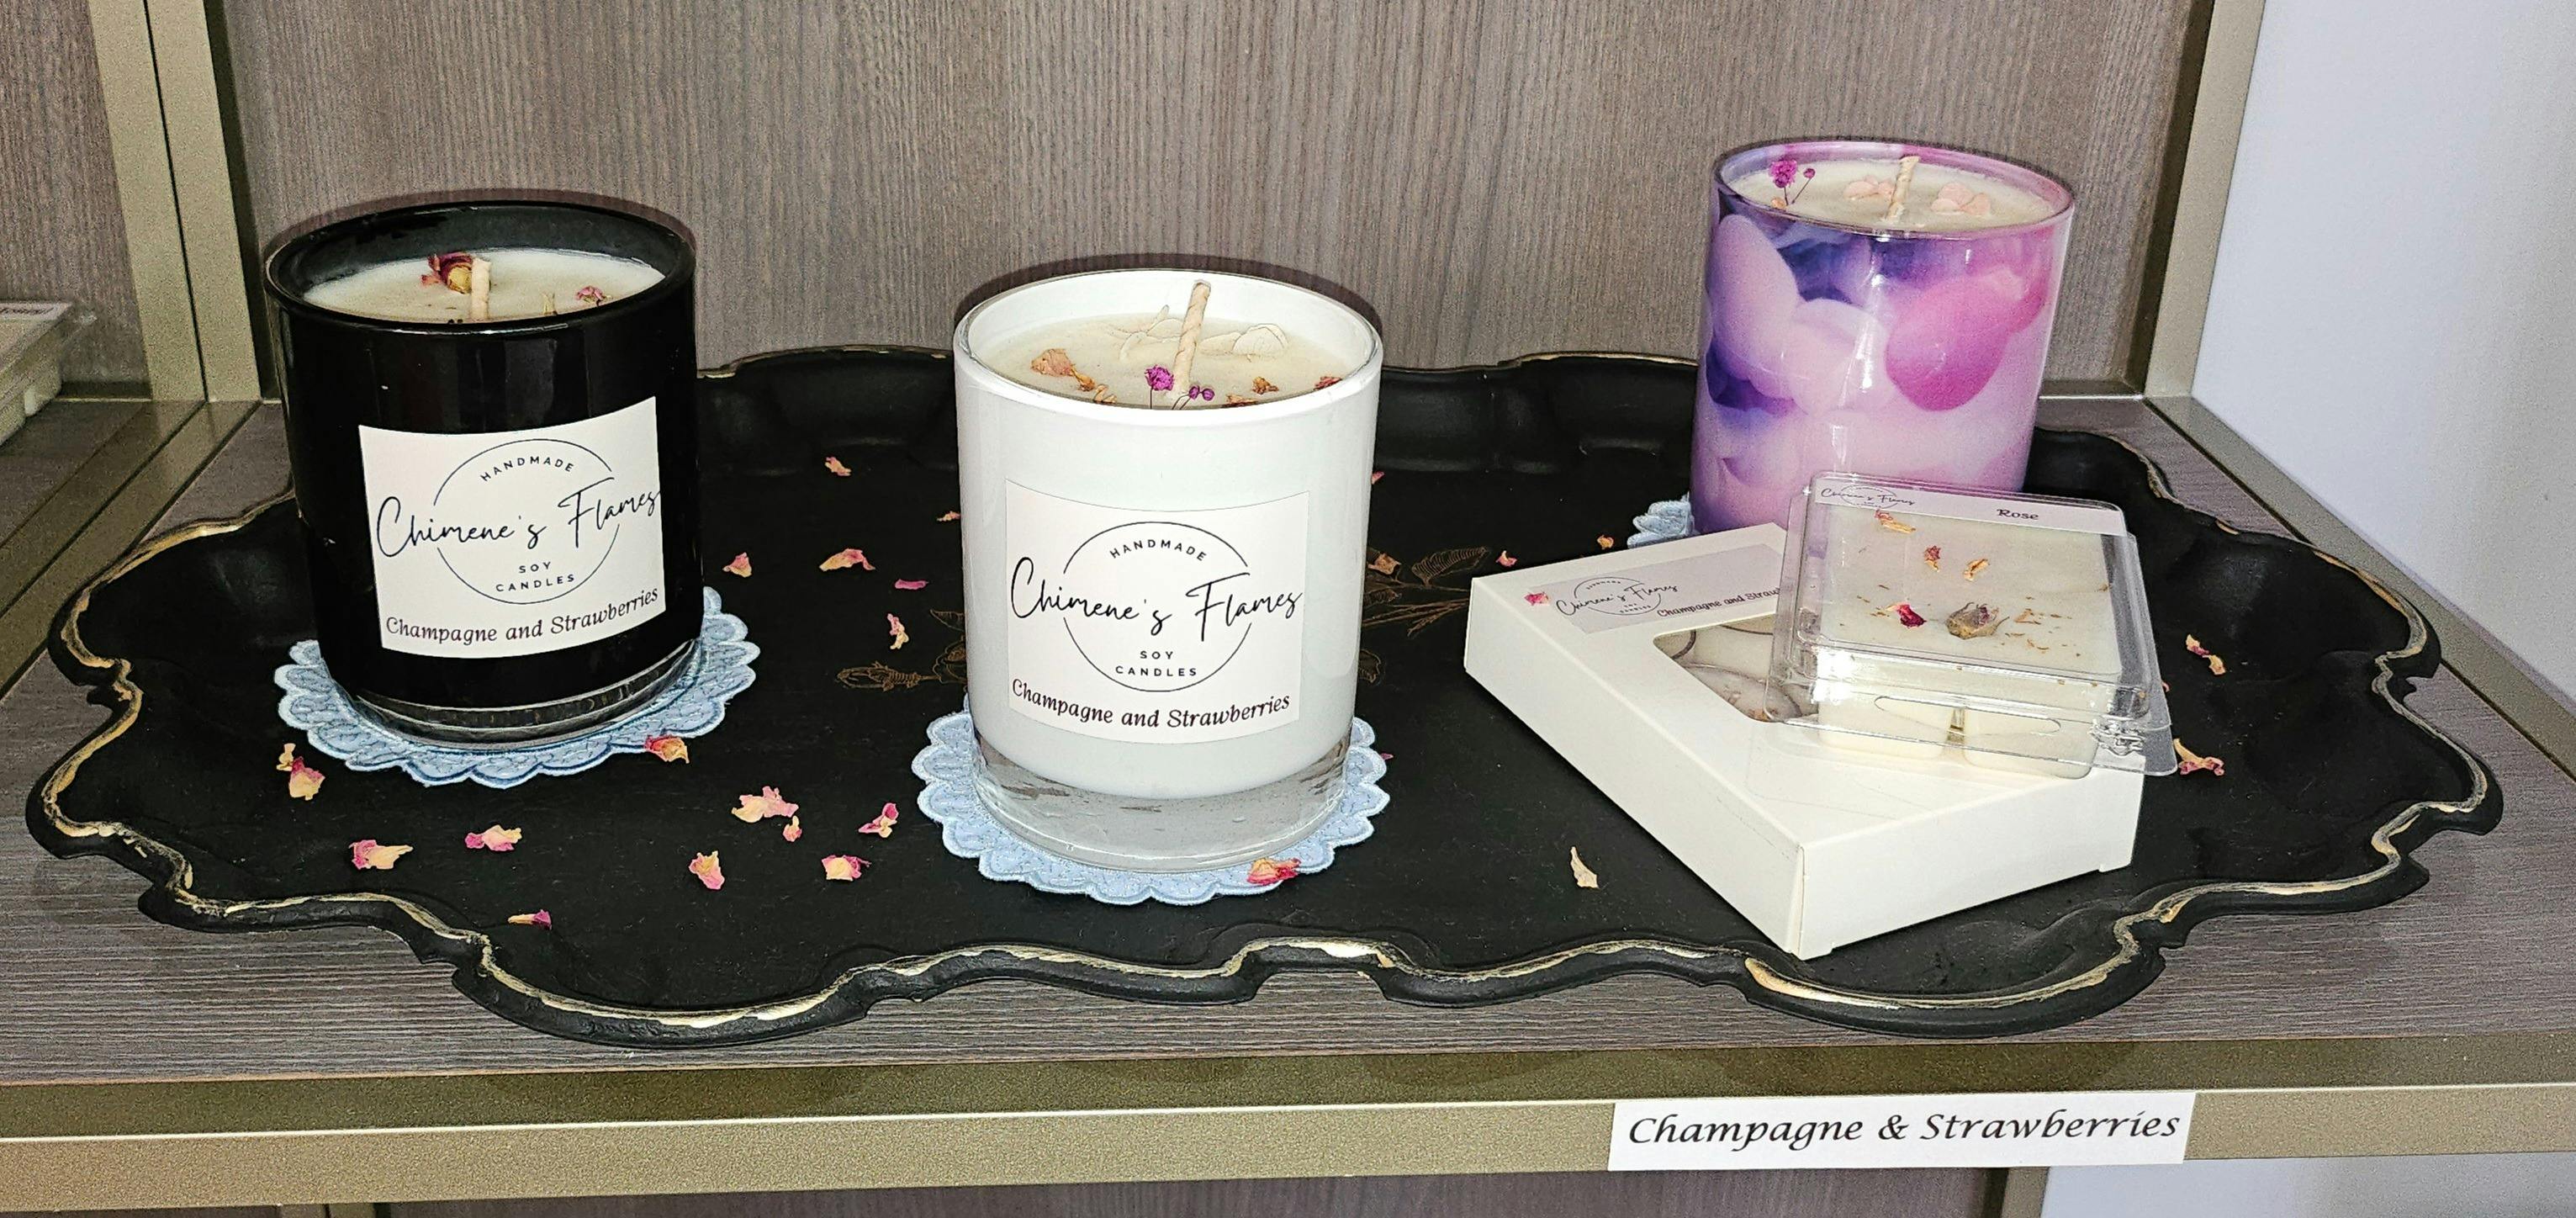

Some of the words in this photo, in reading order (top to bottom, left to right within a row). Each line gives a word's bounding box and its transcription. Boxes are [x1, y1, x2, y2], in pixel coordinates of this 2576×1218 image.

[479, 455, 574, 482] HANDMADE
[376, 495, 547, 558] Chimene's
[557, 476, 661, 548] Flames
[1997, 509, 2039, 521] Rose
[1109, 538, 1207, 562] HANDMADE
[518, 560, 552, 574] SOY
[495, 573, 575, 592] CANDLES
[1010, 556, 1172, 636] Chimene's
[1185, 572, 1304, 642] Flames
[1657, 599, 1722, 618] Champagne
[1723, 595, 1745, 605] and
[386, 616, 498, 646] Champagne
[505, 619, 543, 639] and
[550, 586, 659, 634] Strawberries
[1140, 650, 1174, 660] SOY
[1115, 665, 1198, 676] CANDLES
[1012, 678, 1113, 724] Champagne
[1121, 710, 1160, 728] and
[1166, 694, 1290, 728] Strawberries
[1628, 1113, 1863, 1152] Champagne
[1877, 1115, 1907, 1141] &
[1920, 1109, 2180, 1141] Strawberries
